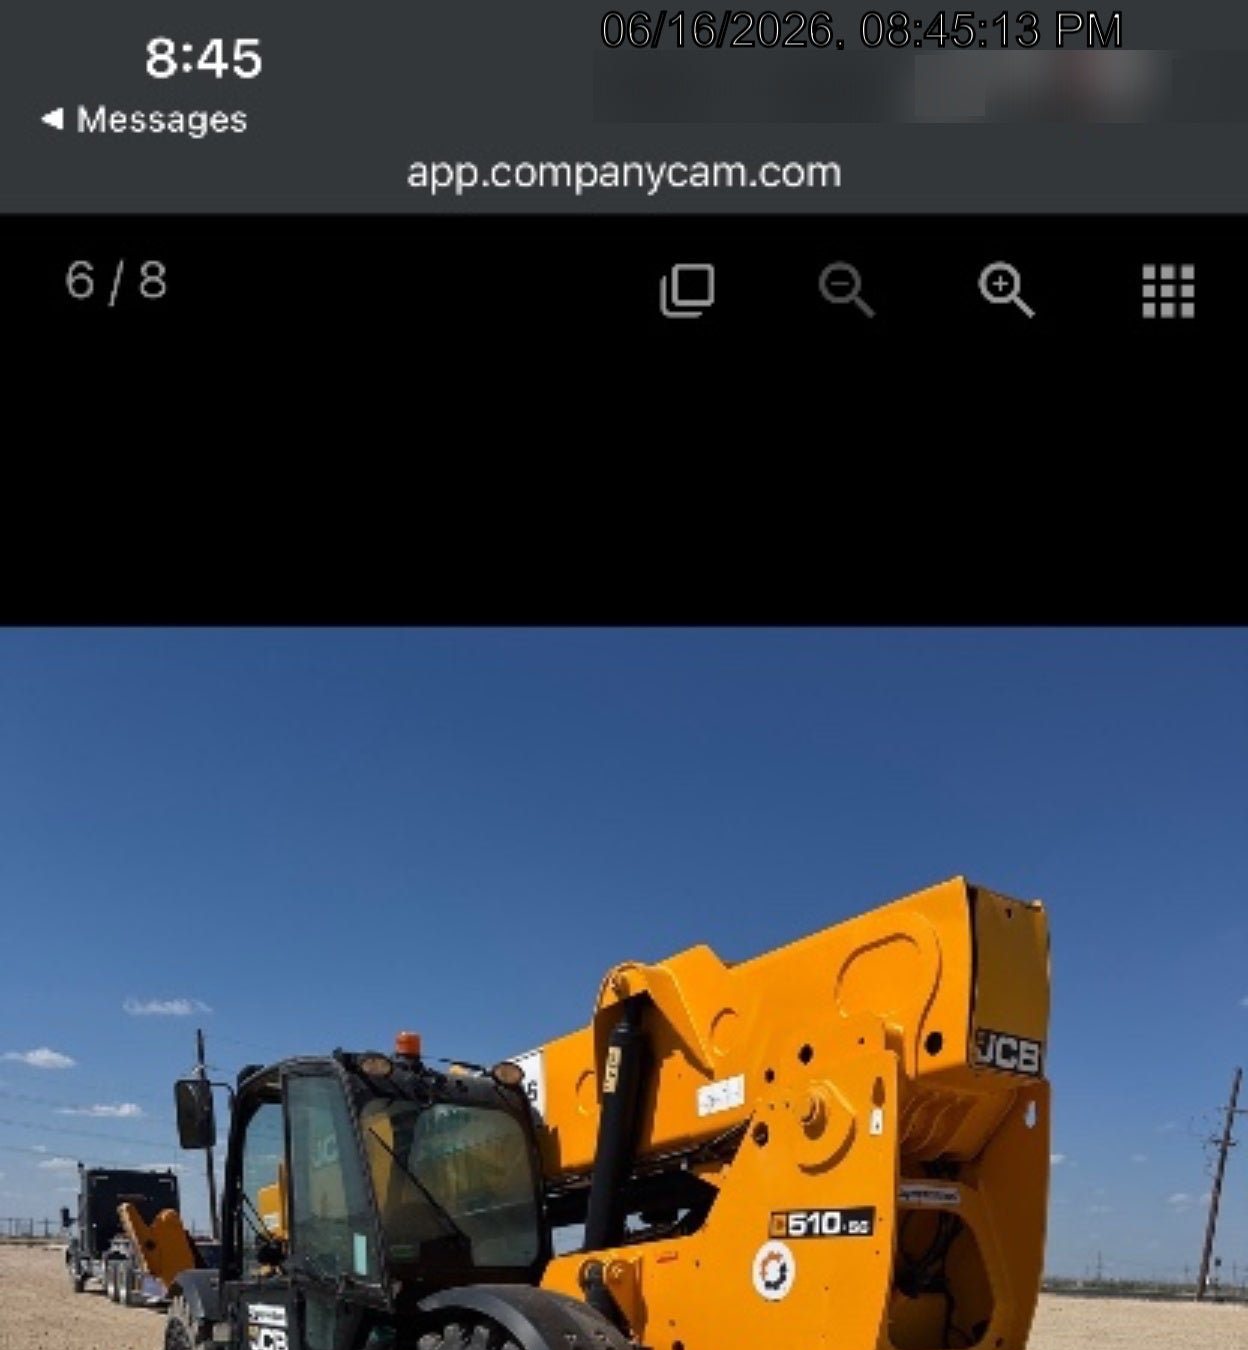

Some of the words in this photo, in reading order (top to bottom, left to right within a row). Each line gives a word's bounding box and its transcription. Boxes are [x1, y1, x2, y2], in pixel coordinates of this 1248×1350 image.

[146, 37, 262, 79] 8:45
[77, 105, 248, 139] Messages
[407, 161, 842, 197] app.companycam.com
[977, 1034, 1039, 1073] JCB
